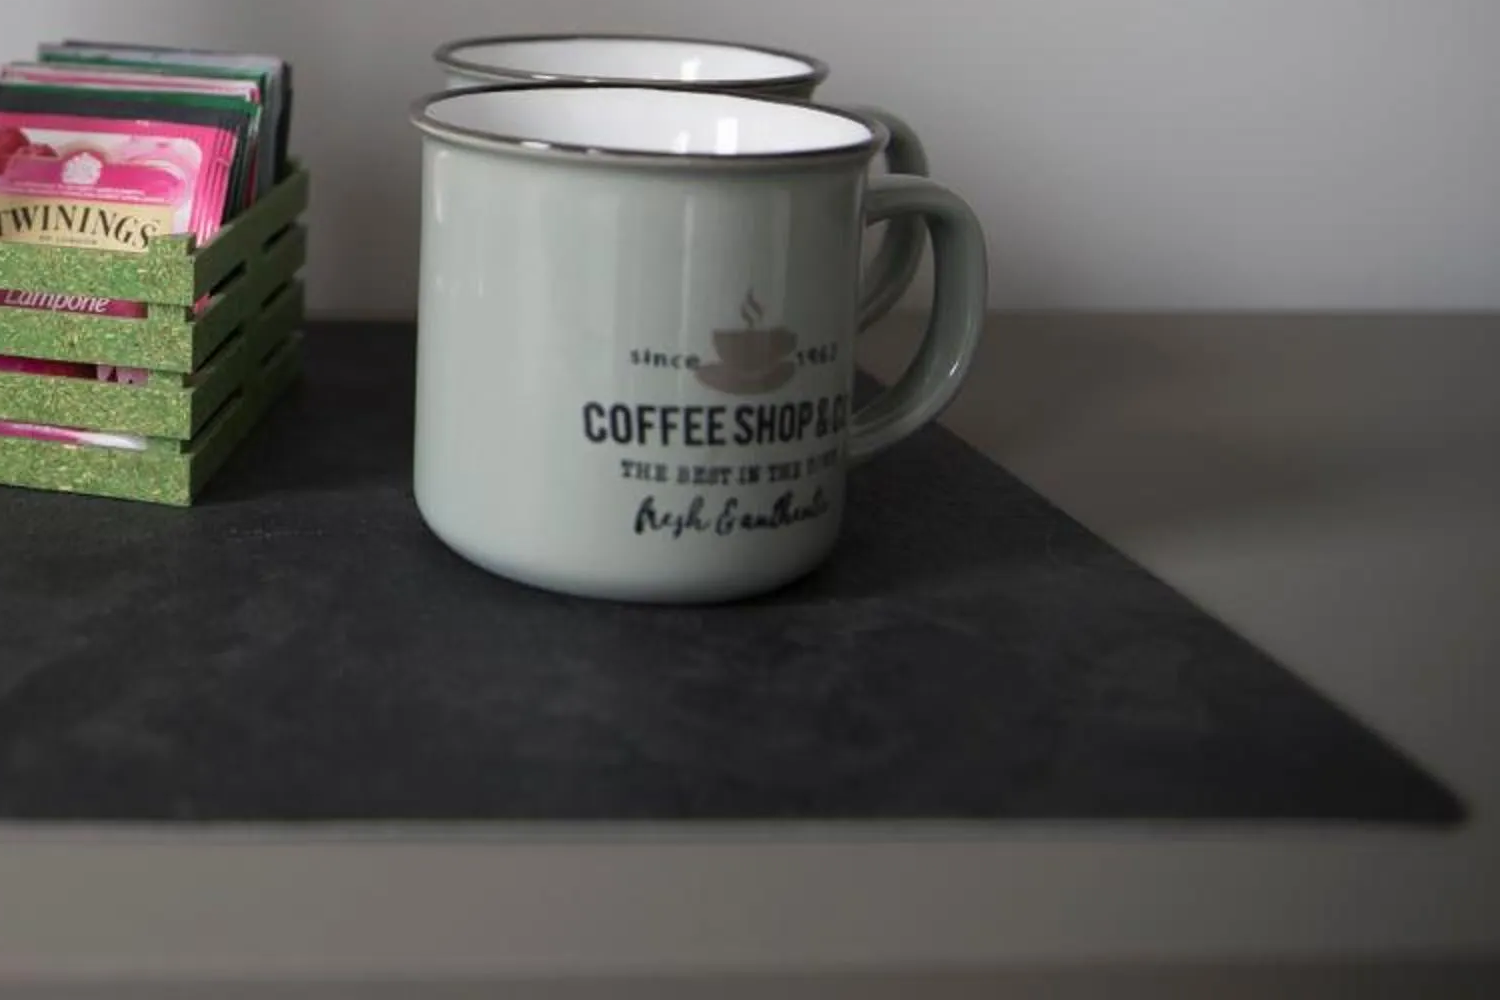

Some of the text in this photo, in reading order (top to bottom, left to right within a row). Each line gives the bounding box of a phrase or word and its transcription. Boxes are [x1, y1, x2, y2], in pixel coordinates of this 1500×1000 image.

[630, 348, 701, 371] since
[583, 402, 726, 447] COFFEE
[734, 400, 813, 446] SHOP
[621, 459, 668, 482] THE
[676, 464, 732, 486] BEST
[738, 465, 760, 485] IN
[634, 495, 711, 540] fresh
